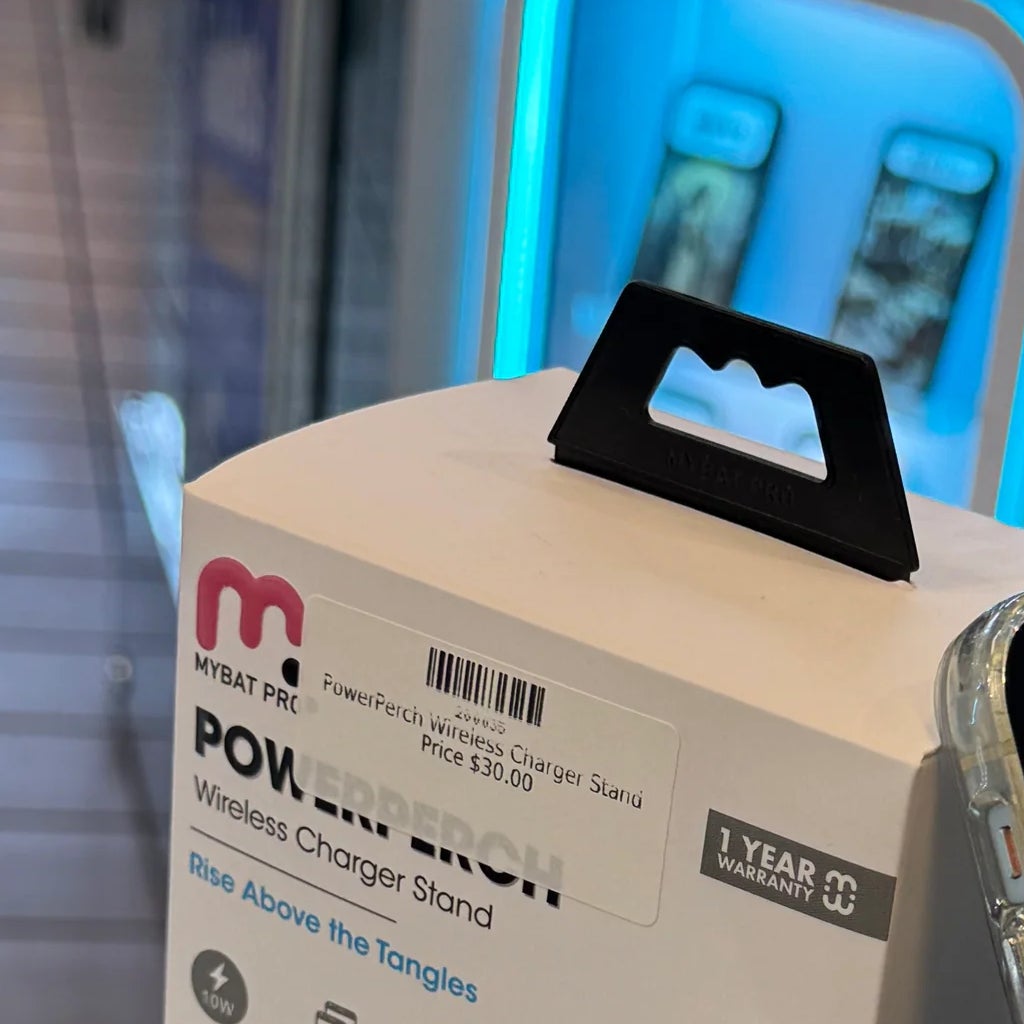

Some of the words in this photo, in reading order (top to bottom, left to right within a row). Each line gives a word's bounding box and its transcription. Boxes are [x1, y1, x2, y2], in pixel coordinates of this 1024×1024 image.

[194, 652, 257, 696] MYBAT
[323, 673, 423, 727] PowerPerch
[430, 712, 504, 757] Wireless
[510, 744, 583, 784] Charger
[590, 773, 643, 809] Stand
[421, 734, 464, 766] Price
[470, 753, 533, 792] $30.00
[194, 774, 288, 842] Wireless
[296, 826, 405, 892] Charger
[413, 875, 493, 929] Stand
[718, 853, 814, 902] WARRANTY
[720, 826, 731, 853] 1
[743, 835, 816, 887] YEAR
[188, 851, 235, 893] Rise
[242, 880, 320, 933] Above
[329, 918, 370, 956] the
[376, 938, 478, 1003] Tangles
[201, 989, 235, 1017] 10W
